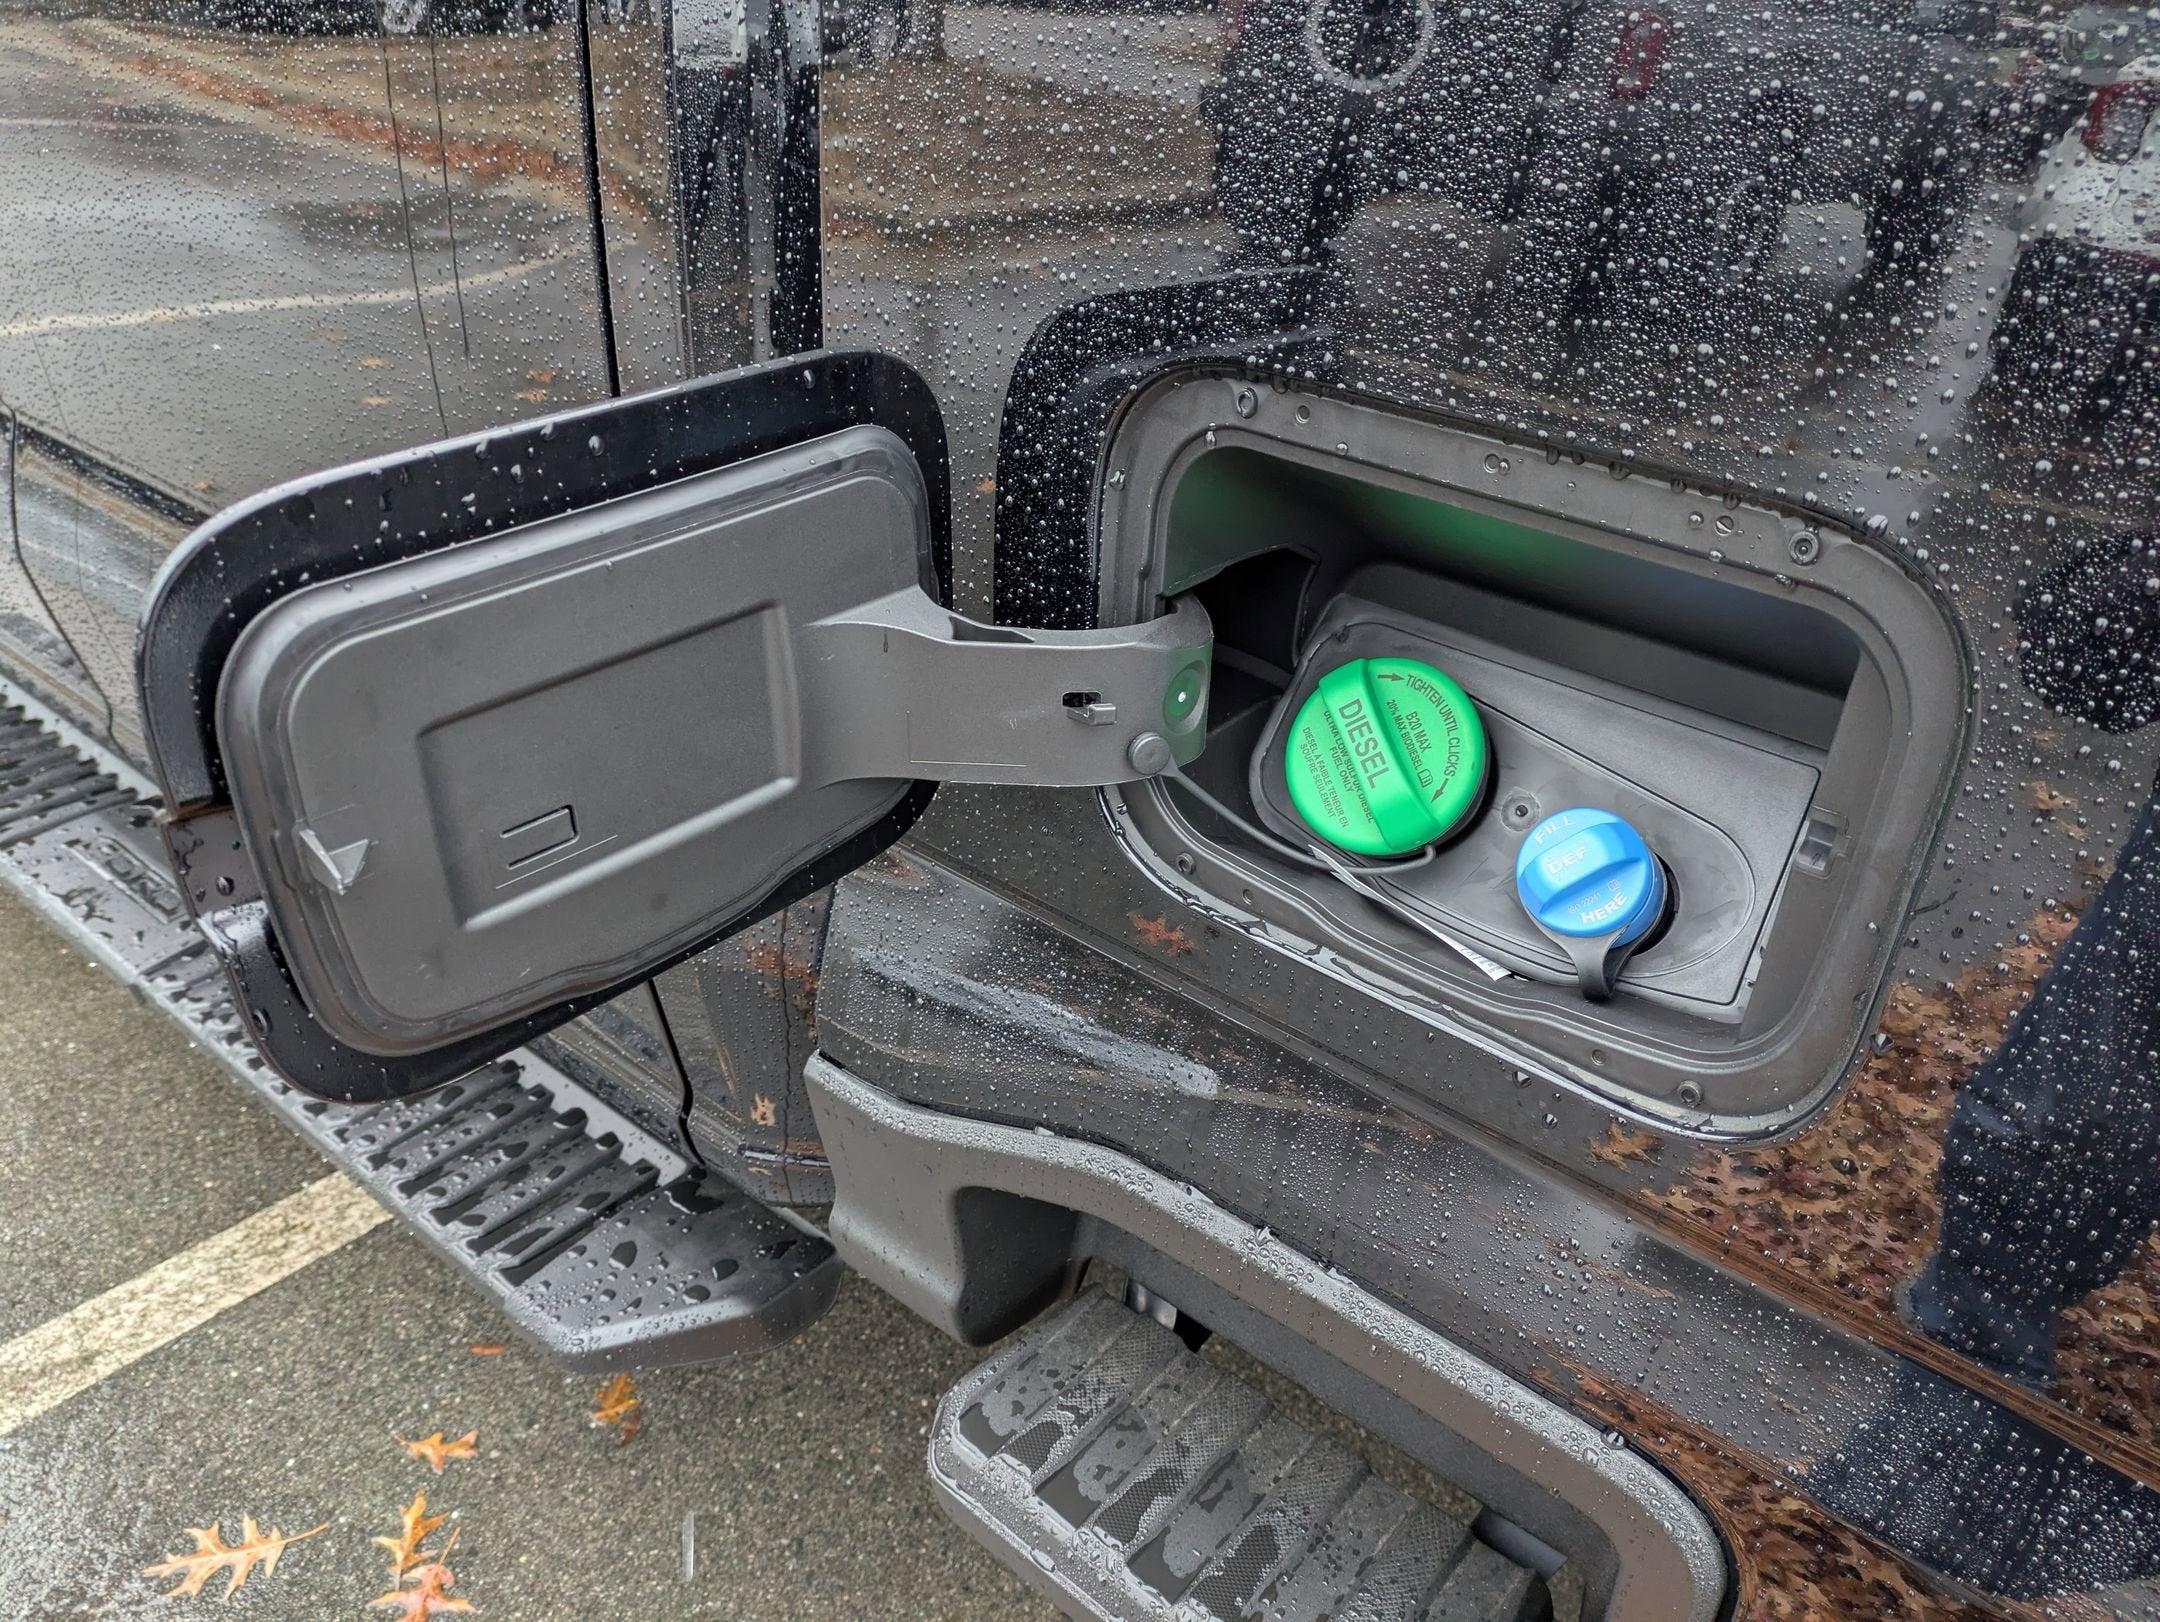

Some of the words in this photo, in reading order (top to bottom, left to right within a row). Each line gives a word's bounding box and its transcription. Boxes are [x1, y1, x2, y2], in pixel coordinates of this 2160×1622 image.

[1406, 674, 1445, 708] TIGHTEN
[1323, 710, 1339, 738] ULTRA
[1335, 737, 1349, 758] LOW
[1386, 700, 1400, 715] 20%
[1393, 714, 1407, 733] MAX
[1401, 731, 1422, 770] BIODIESEL
[1406, 711, 1422, 731] B20
[1414, 730, 1432, 753] MAX
[1439, 704, 1459, 736] UNTIL
[1338, 698, 1389, 789] DIESEL
[1443, 737, 1460, 777] CLICKS
[1300, 743, 1317, 774] SOUFRE
[1312, 773, 1336, 819] SEULEMENT
[1302, 727, 1318, 754] DIESEL
[1318, 759, 1333, 786] FAIBLE
[1326, 785, 1345, 817] TENEUR
[1339, 815, 1350, 828] EN
[1329, 745, 1343, 770] FUEL
[1339, 769, 1354, 793] ONLY
[1533, 815, 1577, 845] FILL
[1546, 847, 1587, 875] DEF
[1580, 891, 1628, 924] HERE
